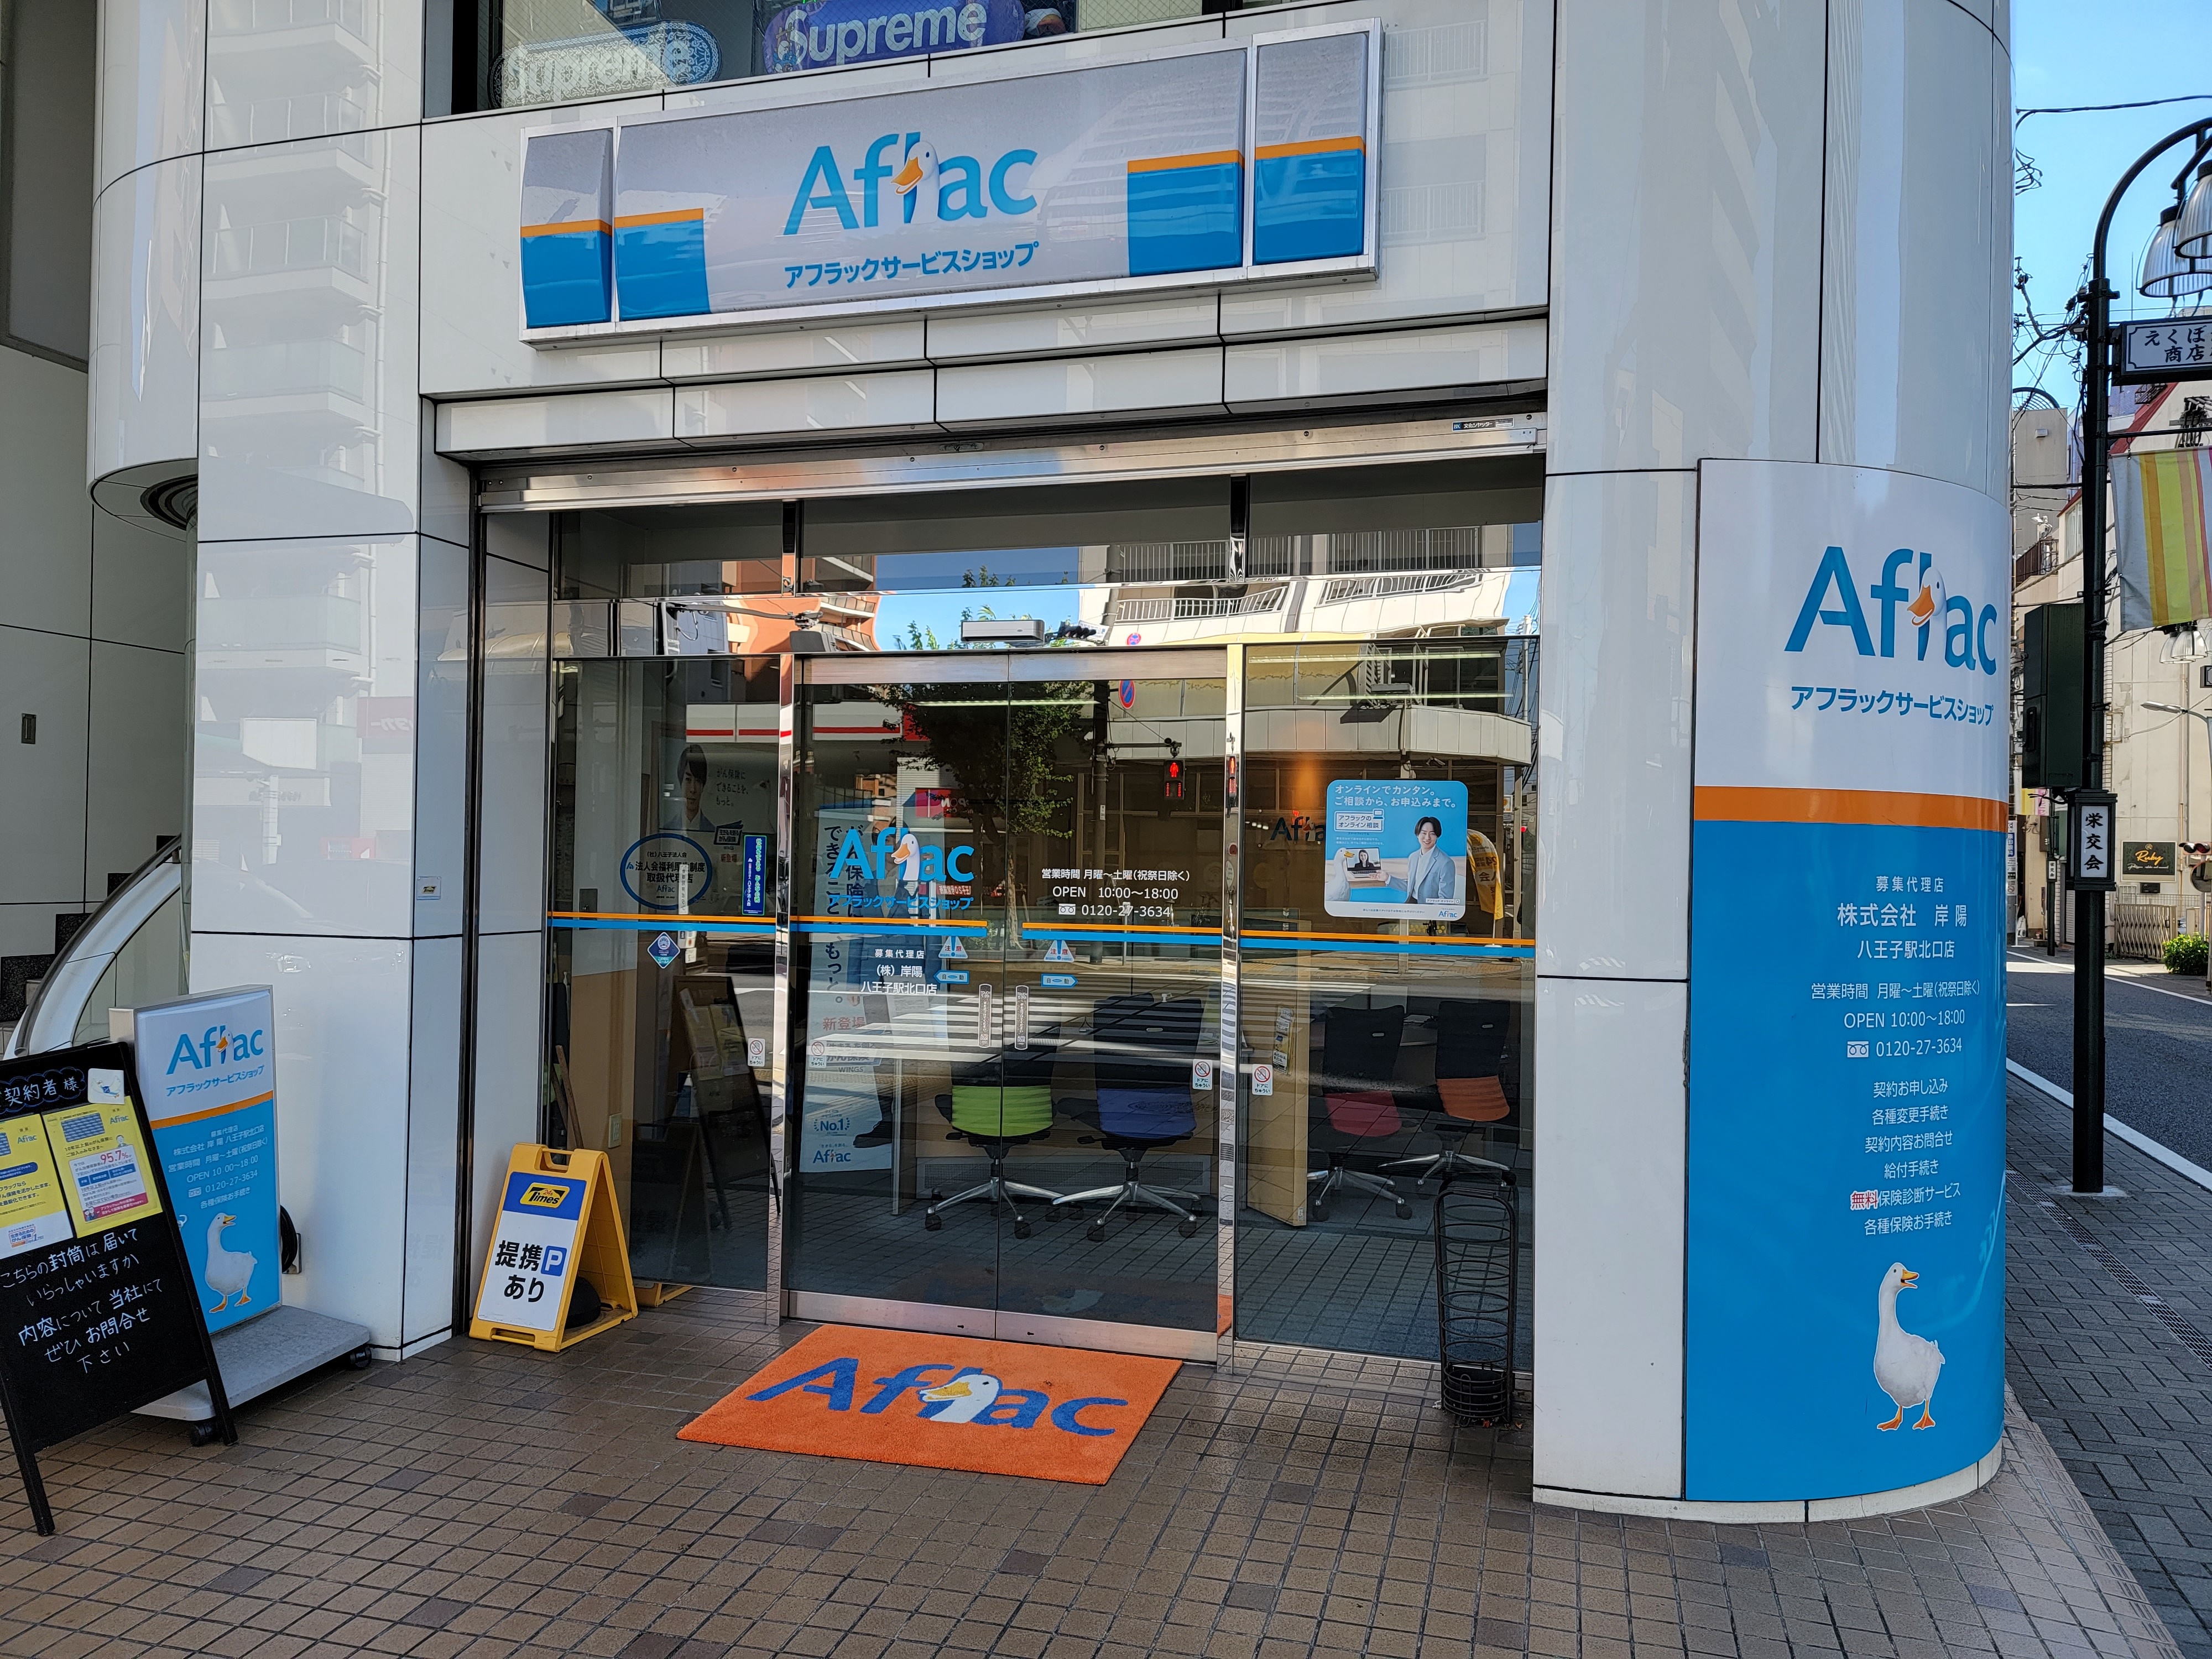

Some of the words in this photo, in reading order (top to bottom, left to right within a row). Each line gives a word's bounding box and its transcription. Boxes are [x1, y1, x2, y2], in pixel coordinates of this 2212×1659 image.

[785, 3, 987, 65] Supreme
[784, 132, 1038, 237] Aflac
[784, 239, 1039, 289] アフラックサービスショップ
[2145, 325, 2212, 347] えくぼ
[2164, 344, 2212, 363] 商店
[1783, 546, 1997, 676] Aflac
[1791, 686, 1994, 726] アフラックサービスショップ
[1334, 785, 1434, 796] オンラインでカンタン。
[1334, 796, 1456, 808] ご相談から、お申込みまで。
[2084, 813, 2104, 870] 栄交会
[830, 827, 974, 882] Aflac
[2135, 849, 2163, 865] Ruby
[635, 862, 706, 873] 法人会福利厚制度
[1042, 869, 1080, 880] 営業時間
[1052, 886, 1086, 898] OPEN
[1876, 876, 1944, 893] 募集代理店
[829, 895, 974, 911] アフラックサービスショップ
[1082, 905, 1171, 917] 0120-27-3634
[1837, 903, 1917, 927] 株式会社
[874, 948, 925, 959] 募集代理店
[1858, 940, 1955, 959] 八王子駅北口店
[861, 980, 937, 995] 八王子駅北口店
[1811, 983, 1868, 1000] 営業時間
[1844, 1013, 1885, 1029] OPEN
[166, 1025, 264, 1075] Aflac
[1876, 1037, 1962, 1057] 0120-27-3634
[166, 1065, 265, 1097] アフラックサービスショップ
[1874, 1078, 1948, 1098] 契約お申し込み
[0, 1076, 79, 1107] 契約者様
[820, 1118, 845, 1132] No.1
[1872, 1105, 1949, 1125] 各種変更手続き
[173, 1142, 205, 1156] 株式会社
[225, 1124, 264, 1144] 八王子駅北口店
[1865, 1130, 1953, 1154] 契約内容お問合せ
[168, 1158, 201, 1173] 営業時間
[812, 1149, 851, 1164] Aflac
[186, 1170, 210, 1183] OPEN
[1884, 1159, 1939, 1180] 給付手続き
[205, 1170, 258, 1193] 0120-27-3634
[200, 1187, 251, 1209] 各種保険お手続き
[528, 1191, 560, 1204] Times
[1850, 1182, 1961, 1211] 無料保険診断サービス
[1864, 1210, 1953, 1235] 各種保険お手続き
[27, 1254, 139, 1306] いらっしゃいますか
[504, 1274, 545, 1302] あり
